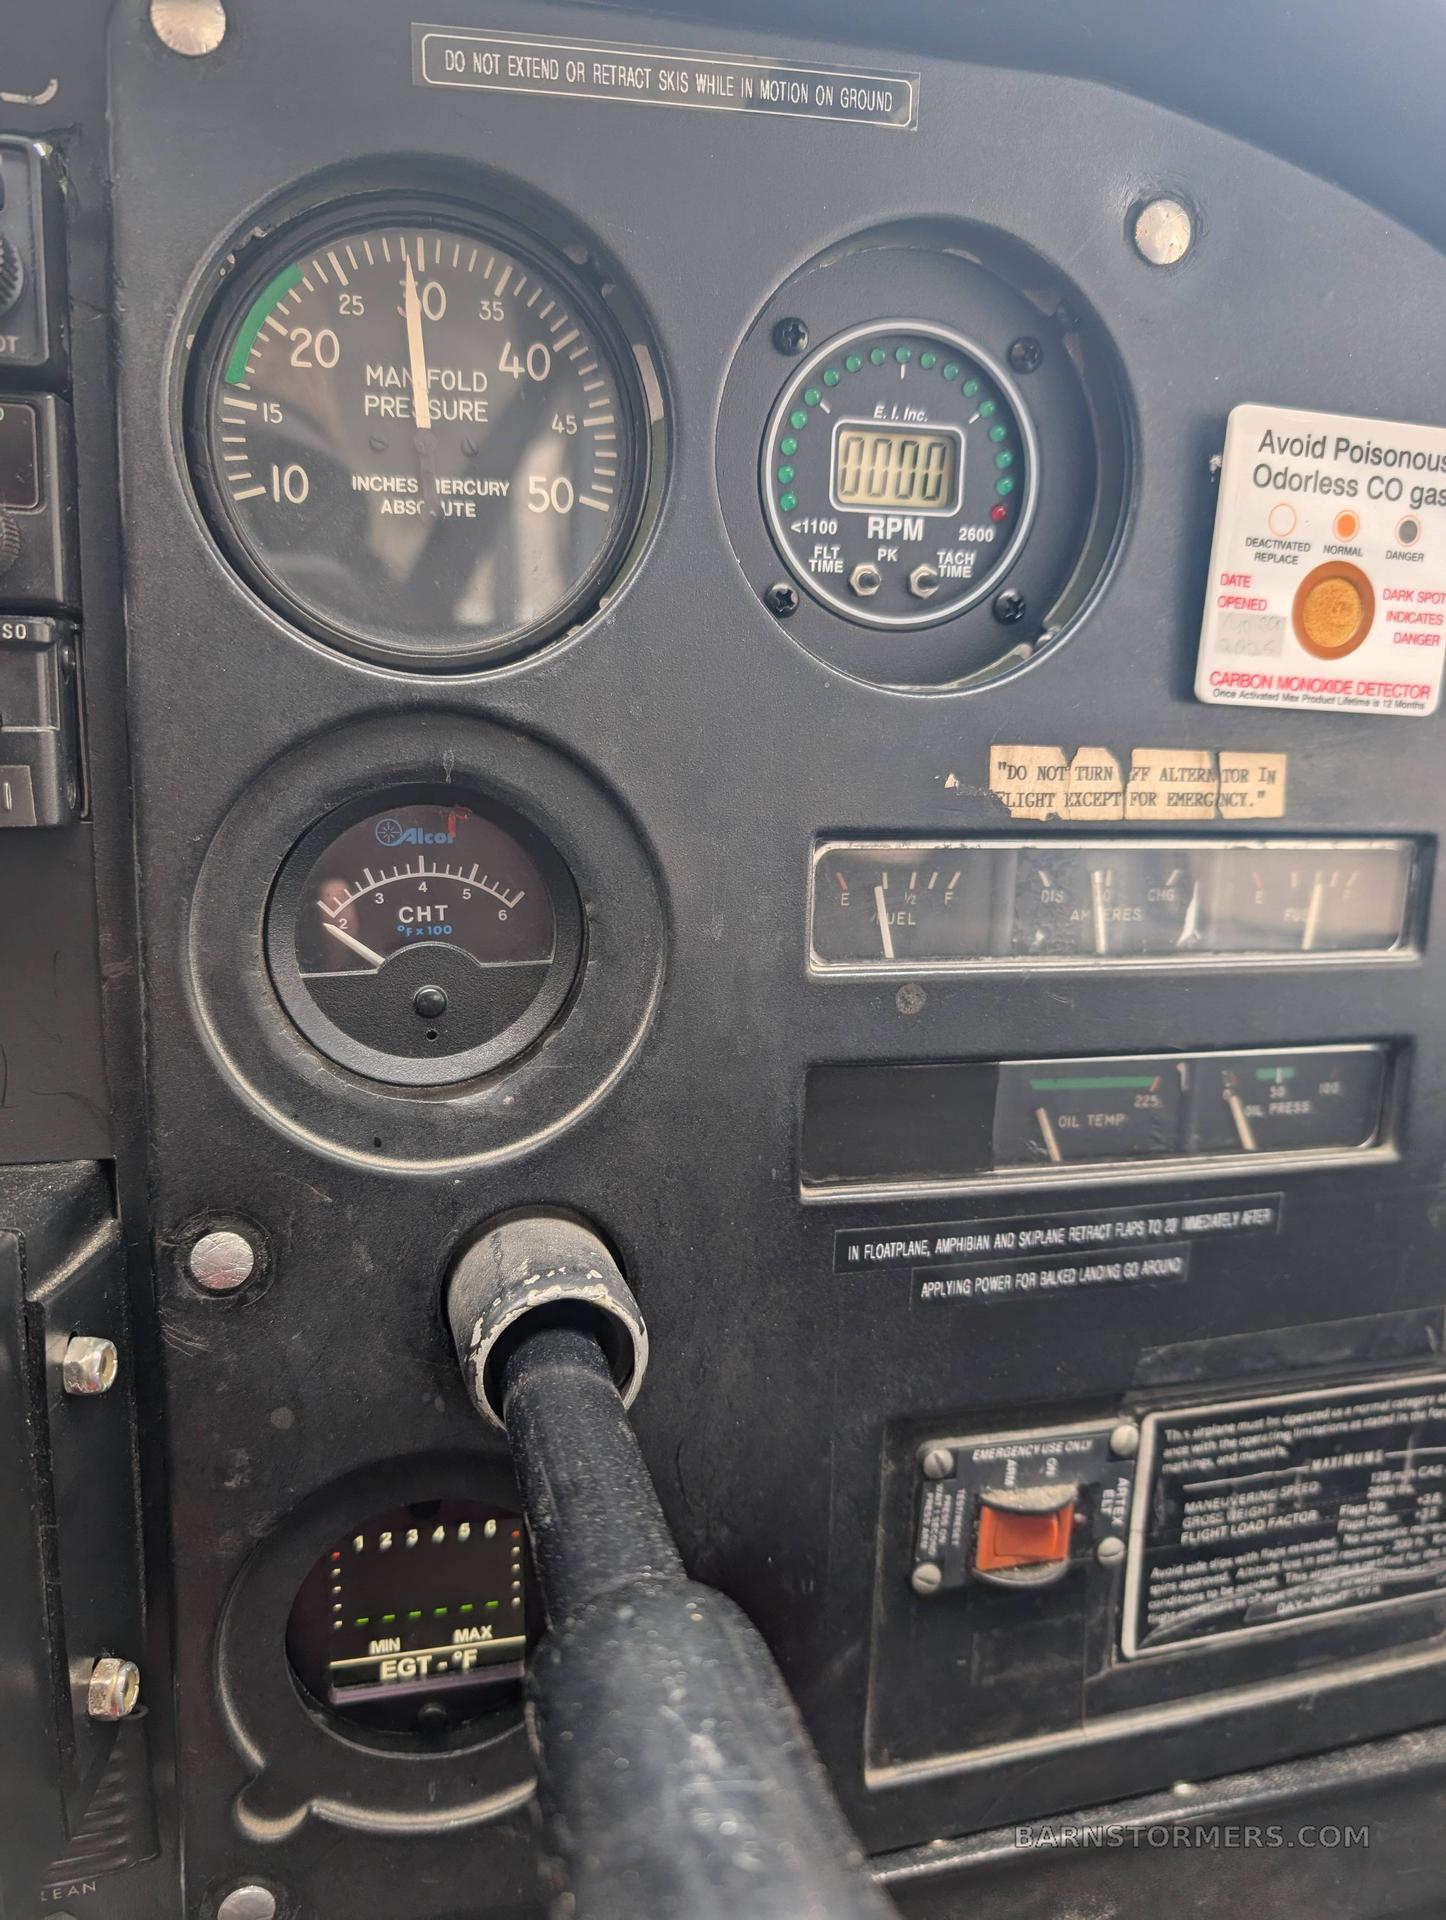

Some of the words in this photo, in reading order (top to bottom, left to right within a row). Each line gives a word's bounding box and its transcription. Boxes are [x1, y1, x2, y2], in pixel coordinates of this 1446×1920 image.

[445, 49, 465, 73] DO
[473, 51, 500, 76] NOT
[508, 54, 559, 80] EXTEND
[566, 60, 585, 83] OR
[593, 64, 650, 89] RETRACT
[659, 70, 689, 93] SKIS
[696, 73, 734, 97] WHILE
[741, 76, 753, 98] IN
[760, 78, 809, 104] MOTION
[816, 85, 833, 107] ON
[841, 87, 893, 112] GROUND
[339, 294, 364, 315] 25
[479, 300, 504, 321] 35
[290, 328, 340, 369] 20
[499, 341, 551, 381] 40
[366, 364, 488, 393] MANFOLD
[263, 402, 283, 424] 15
[364, 395, 489, 422] PRESURE
[903, 407, 929, 422] Inc.
[552, 415, 577, 435] 45
[1258, 429, 1327, 459] Avoid
[1334, 437, 1446, 473] Poisonous
[272, 465, 309, 504] 10
[352, 475, 418, 493] INCHES
[434, 479, 510, 497] ERCURY
[1253, 464, 1359, 497] Odorless
[1366, 475, 1403, 502] CO
[1409, 486, 1446, 509] gas
[528, 476, 574, 514] 50
[380, 500, 477, 518] ABSUTE
[791, 519, 838, 535] <1100
[867, 517, 925, 541] RPM
[958, 528, 994, 542] 2600
[814, 546, 838, 560] FLT
[1245, 537, 1311, 553] DEACTIVATED
[1323, 545, 1363, 557] NORMAL
[877, 548, 898, 562] PK
[937, 551, 976, 565] TACH
[1254, 552, 1299, 565] REPLACE
[1385, 550, 1424, 562] DANGER
[809, 559, 844, 574] TIME
[938, 564, 972, 579] TIME
[1220, 573, 1252, 588] DATE
[1217, 595, 1267, 612] OPENED
[1382, 588, 1414, 602] DARK
[1416, 590, 1446, 605] SPOT
[1386, 611, 1443, 626] INDICATES
[1393, 632, 1440, 647] DANGER
[1209, 671, 1272, 690] CARBON
[1276, 676, 1352, 696] MONOXIDE
[1356, 682, 1431, 700] DETECTOR
[1212, 688, 1237, 698] Once
[1239, 690, 1279, 702] Activated
[1302, 694, 1334, 705] Product
[1337, 696, 1371, 707] Lifetime
[1382, 699, 1392, 708] 12
[1394, 700, 1425, 710] Months
[1037, 766, 1067, 781] NOT
[1075, 766, 1114, 781] TURN
[1159, 767, 1249, 784] ALTERNTOR
[1065, 791, 1121, 808] EXCEPT
[1130, 792, 1157, 807] FOR
[418, 881, 428, 893] 4
[463, 888, 472, 900] 5
[1041, 889, 1064, 903] DIS
[1147, 889, 1176, 901] CHG
[375, 893, 385, 905] 3
[841, 893, 850, 906] E
[945, 892, 953, 905] F
[399, 904, 449, 924] CHT
[498, 909, 508, 921] 6
[339, 918, 348, 930] 2
[427, 925, 453, 936] 100
[1269, 1085, 1286, 1099] 50
[1268, 1100, 1311, 1115] PRESS
[1058, 1115, 1079, 1128] OIL
[1087, 1114, 1126, 1127] TEMP
[848, 1244, 859, 1261] IN
[864, 1239, 931, 1260] FLOATPLANE,
[935, 1235, 989, 1255] AMPHIBIAN
[994, 1233, 1015, 1249] AND
[1018, 1229, 1065, 1249] SKIPLANE
[1069, 1223, 1112, 1243] RETRACT
[1115, 1220, 1144, 1239] FLAPS
[1148, 1218, 1161, 1235] TO
[1182, 1211, 1240, 1231] IMMEDIATELY
[921, 1278, 971, 1299] APPLYING
[975, 1274, 1011, 1293] POWER
[1015, 1271, 1036, 1289] FOR
[1040, 1268, 1076, 1286] BALKED
[1080, 1263, 1121, 1282] LANDING
[1124, 1261, 1139, 1278] GO
[1141, 1257, 1182, 1276] AROUND
[972, 1445, 1041, 1461] EMERGENCY
[1041, 1442, 1063, 1455] USE
[1064, 1440, 1094, 1452] ONLY
[1310, 1449, 1384, 1472] MAXIMUMS
[1184, 1489, 1280, 1515] MANEUVERING
[1280, 1481, 1322, 1498] SPEED
[1182, 1511, 1225, 1529] GROSS
[1226, 1502, 1276, 1522] WEIGHT
[352, 1535, 364, 1552] 1
[379, 1531, 393, 1551] 2
[405, 1528, 418, 1548] 3
[432, 1524, 445, 1544] 4
[457, 1522, 470, 1542] 5
[484, 1518, 497, 1539] 6
[1181, 1525, 1230, 1546] FLIGHT
[1230, 1519, 1266, 1536] LOAD
[1267, 1509, 1319, 1529] FACTOR
[453, 1625, 492, 1644] MAX
[369, 1637, 401, 1655] MIN
[380, 1655, 433, 1680] EGT
[41, 1881, 97, 1902] LEAN
